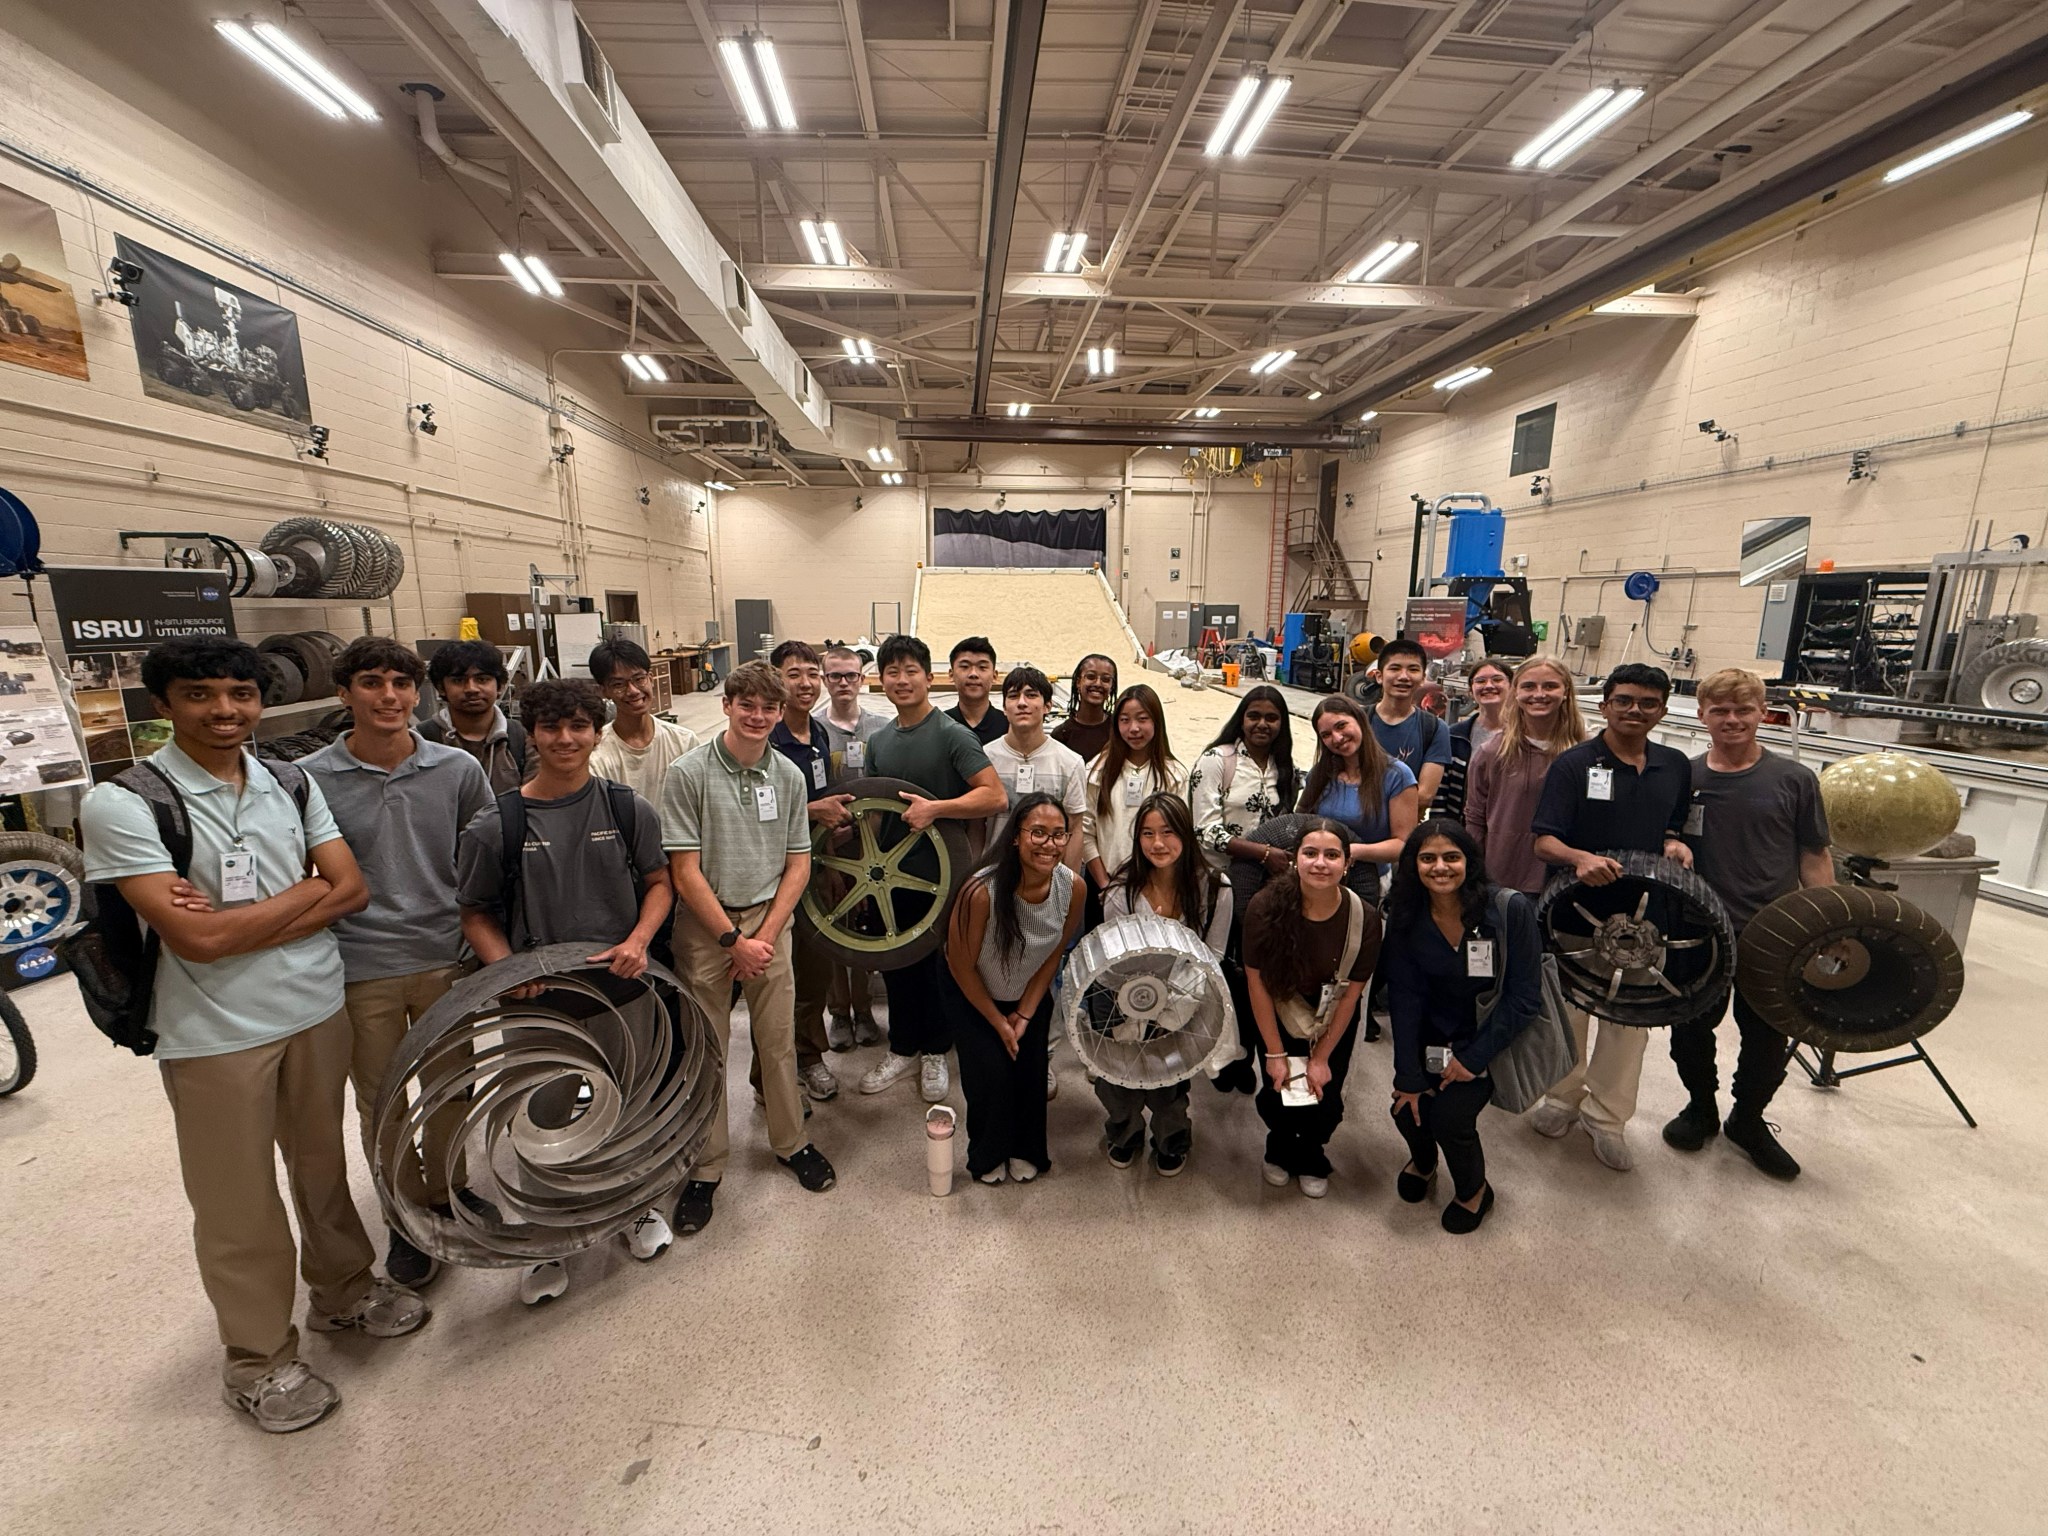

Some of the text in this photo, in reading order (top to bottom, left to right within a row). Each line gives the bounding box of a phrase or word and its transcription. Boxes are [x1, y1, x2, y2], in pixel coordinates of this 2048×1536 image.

[72, 619, 143, 639] ISRU
[156, 627, 227, 637] UTILIZATION
[18, 955, 55, 971] NASA
